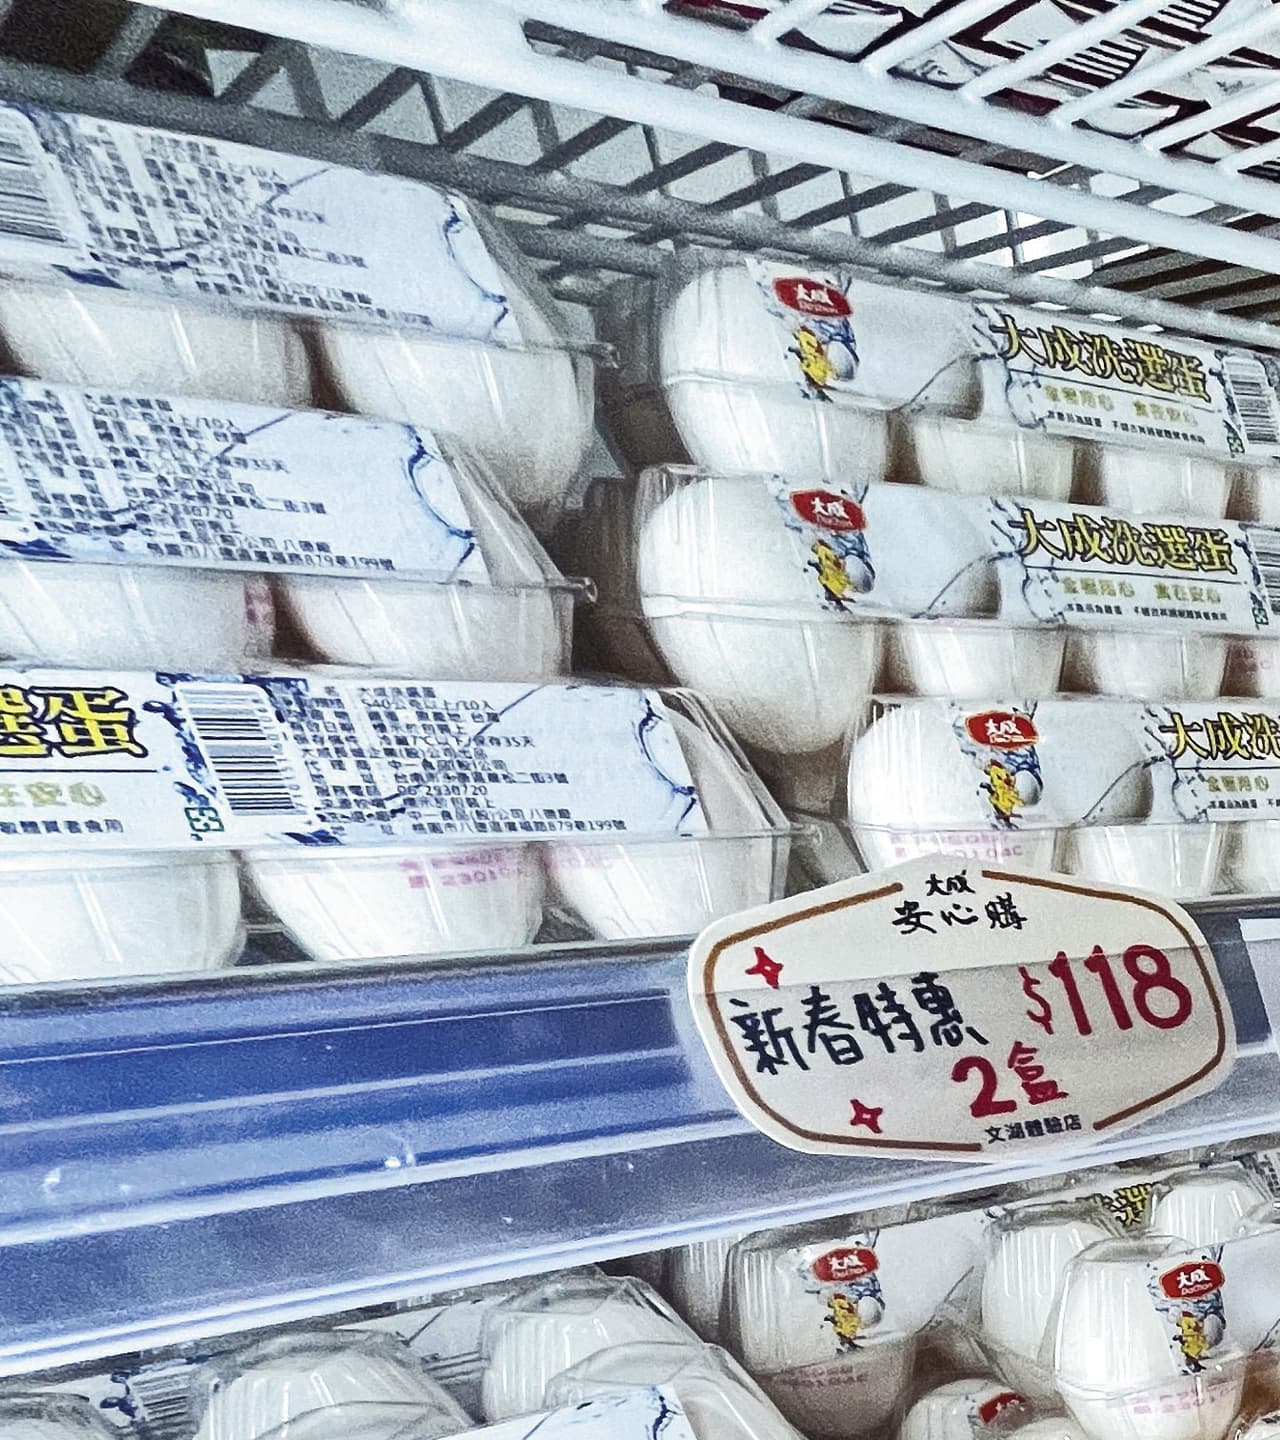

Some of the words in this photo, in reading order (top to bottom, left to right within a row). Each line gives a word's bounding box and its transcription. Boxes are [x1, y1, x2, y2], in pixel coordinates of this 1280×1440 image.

[988, 313, 1211, 401] 大成洗選蛋
[1009, 508, 1237, 573] 大成洗選蛋
[926, 870, 973, 896] 大成
[892, 893, 1028, 934] 安心購
[729, 972, 988, 1075] 新春特惠
[1018, 943, 1193, 1036] $118
[950, 1040, 1068, 1118] 2盒
[984, 1113, 1082, 1144] 文湖體驗店
[1176, 1265, 1211, 1289] 大成
